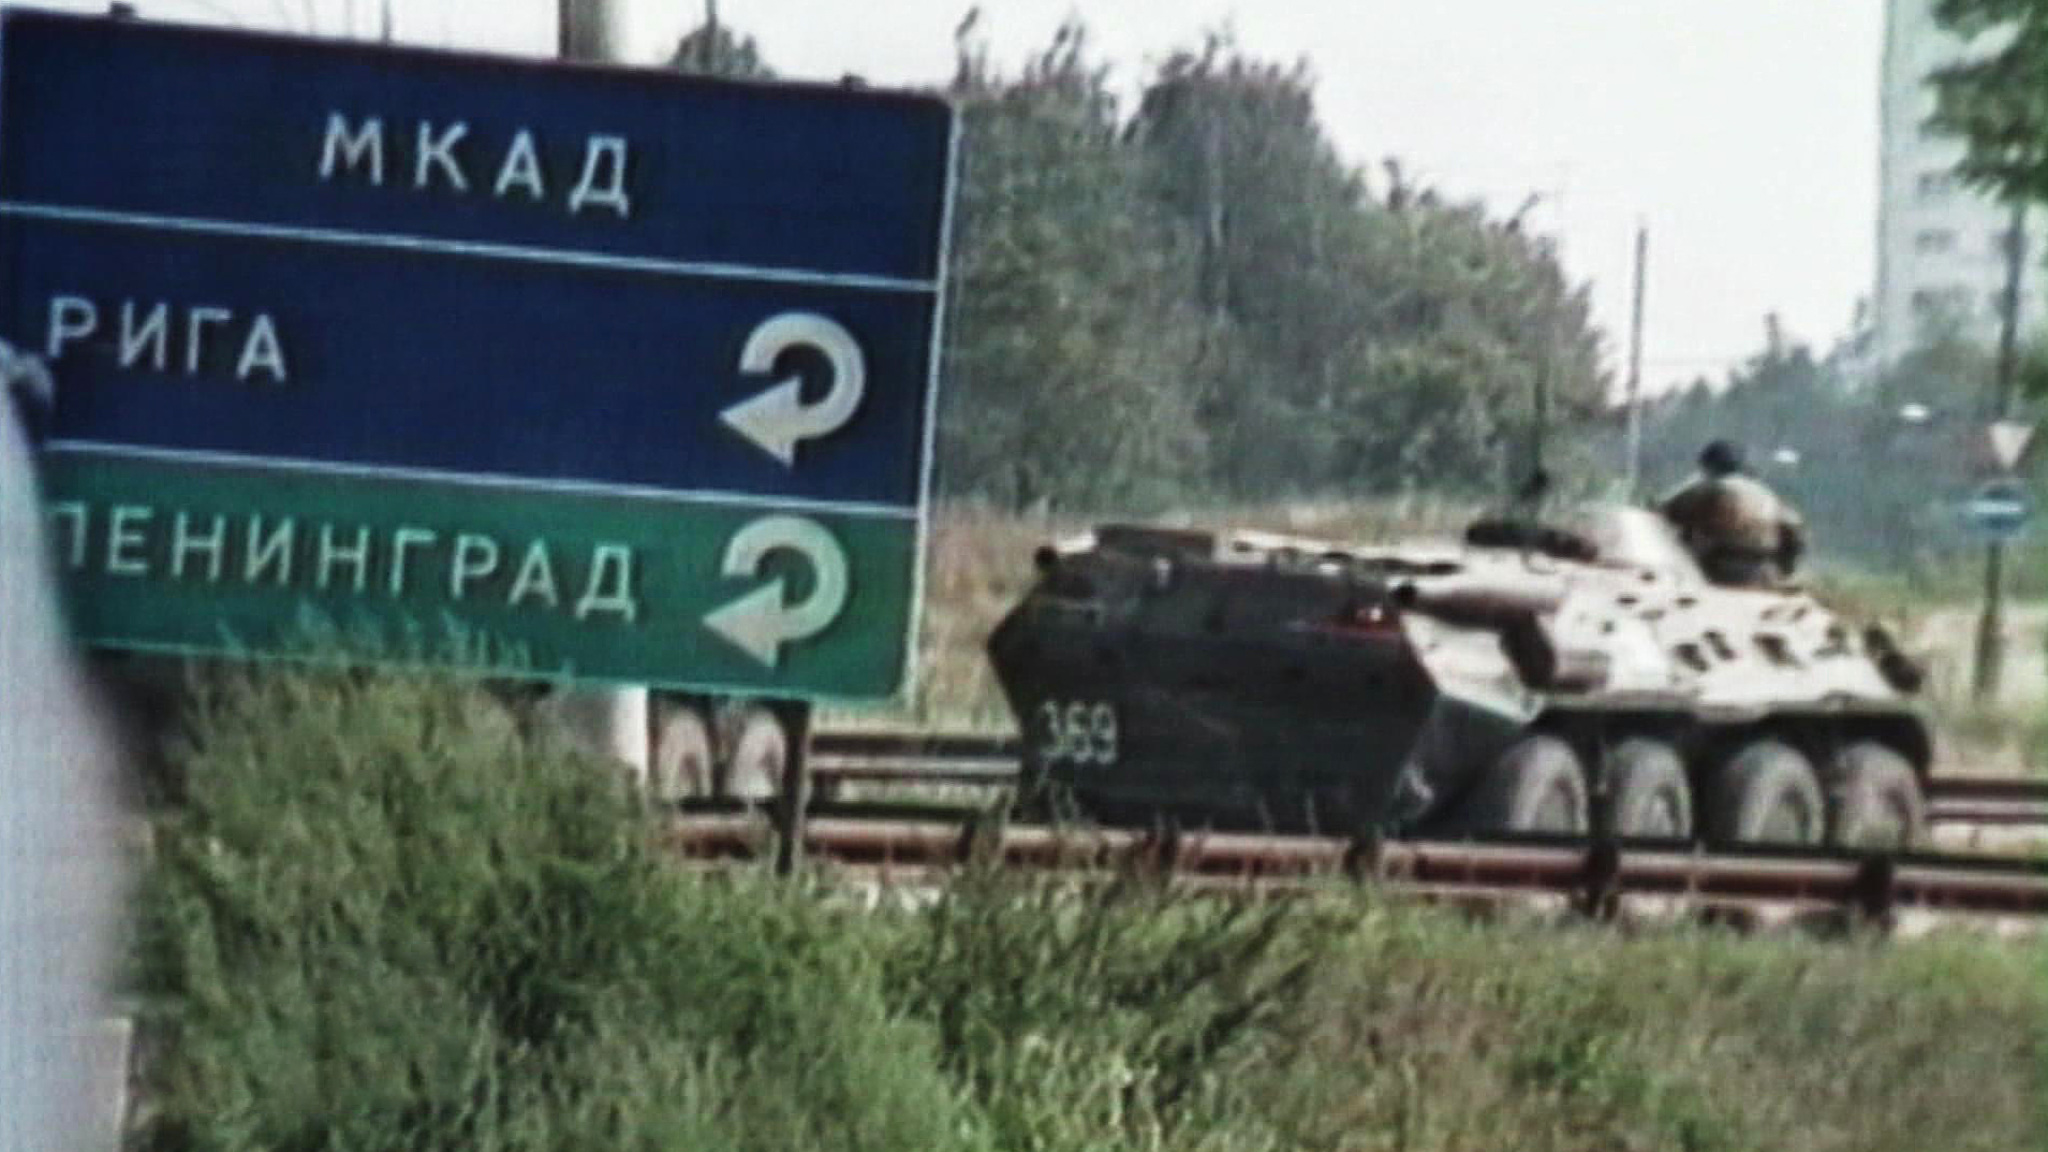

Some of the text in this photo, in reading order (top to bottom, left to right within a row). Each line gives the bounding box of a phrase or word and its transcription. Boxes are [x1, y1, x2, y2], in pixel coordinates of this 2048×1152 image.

[318, 110, 629, 219] МКАД
[46, 296, 287, 382] РИГА
[1039, 699, 1118, 765] 369
